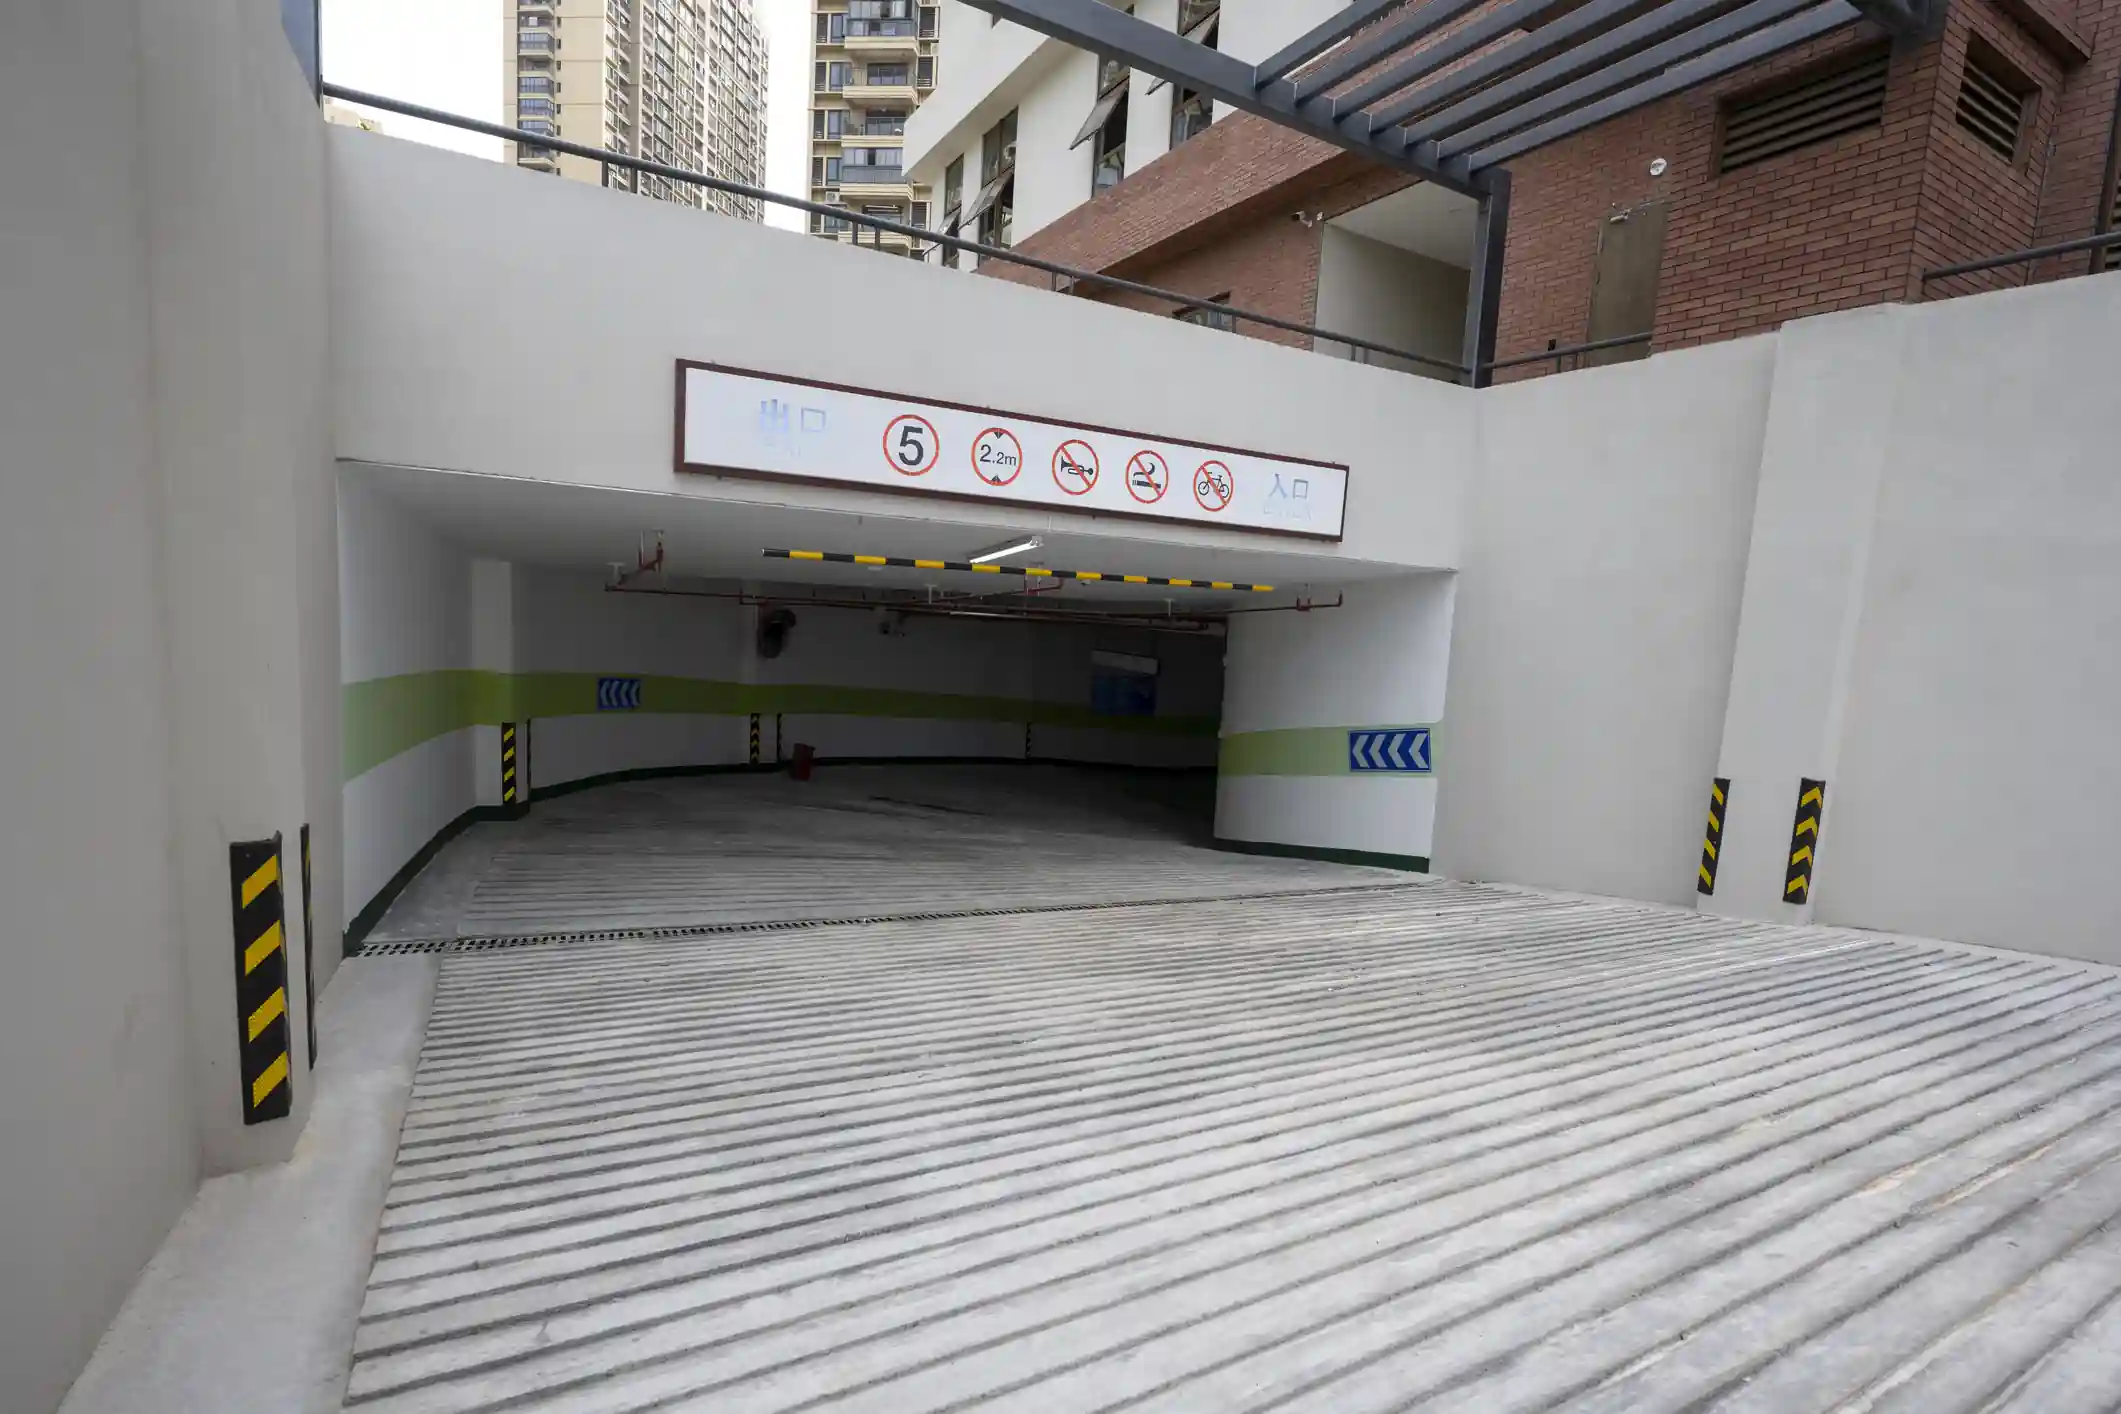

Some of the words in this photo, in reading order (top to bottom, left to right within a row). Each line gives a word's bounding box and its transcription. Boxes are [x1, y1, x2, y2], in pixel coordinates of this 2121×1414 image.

[898, 425, 924, 466] 5
[980, 444, 1017, 466] 2.2m
[1268, 473, 1309, 500] 入口
